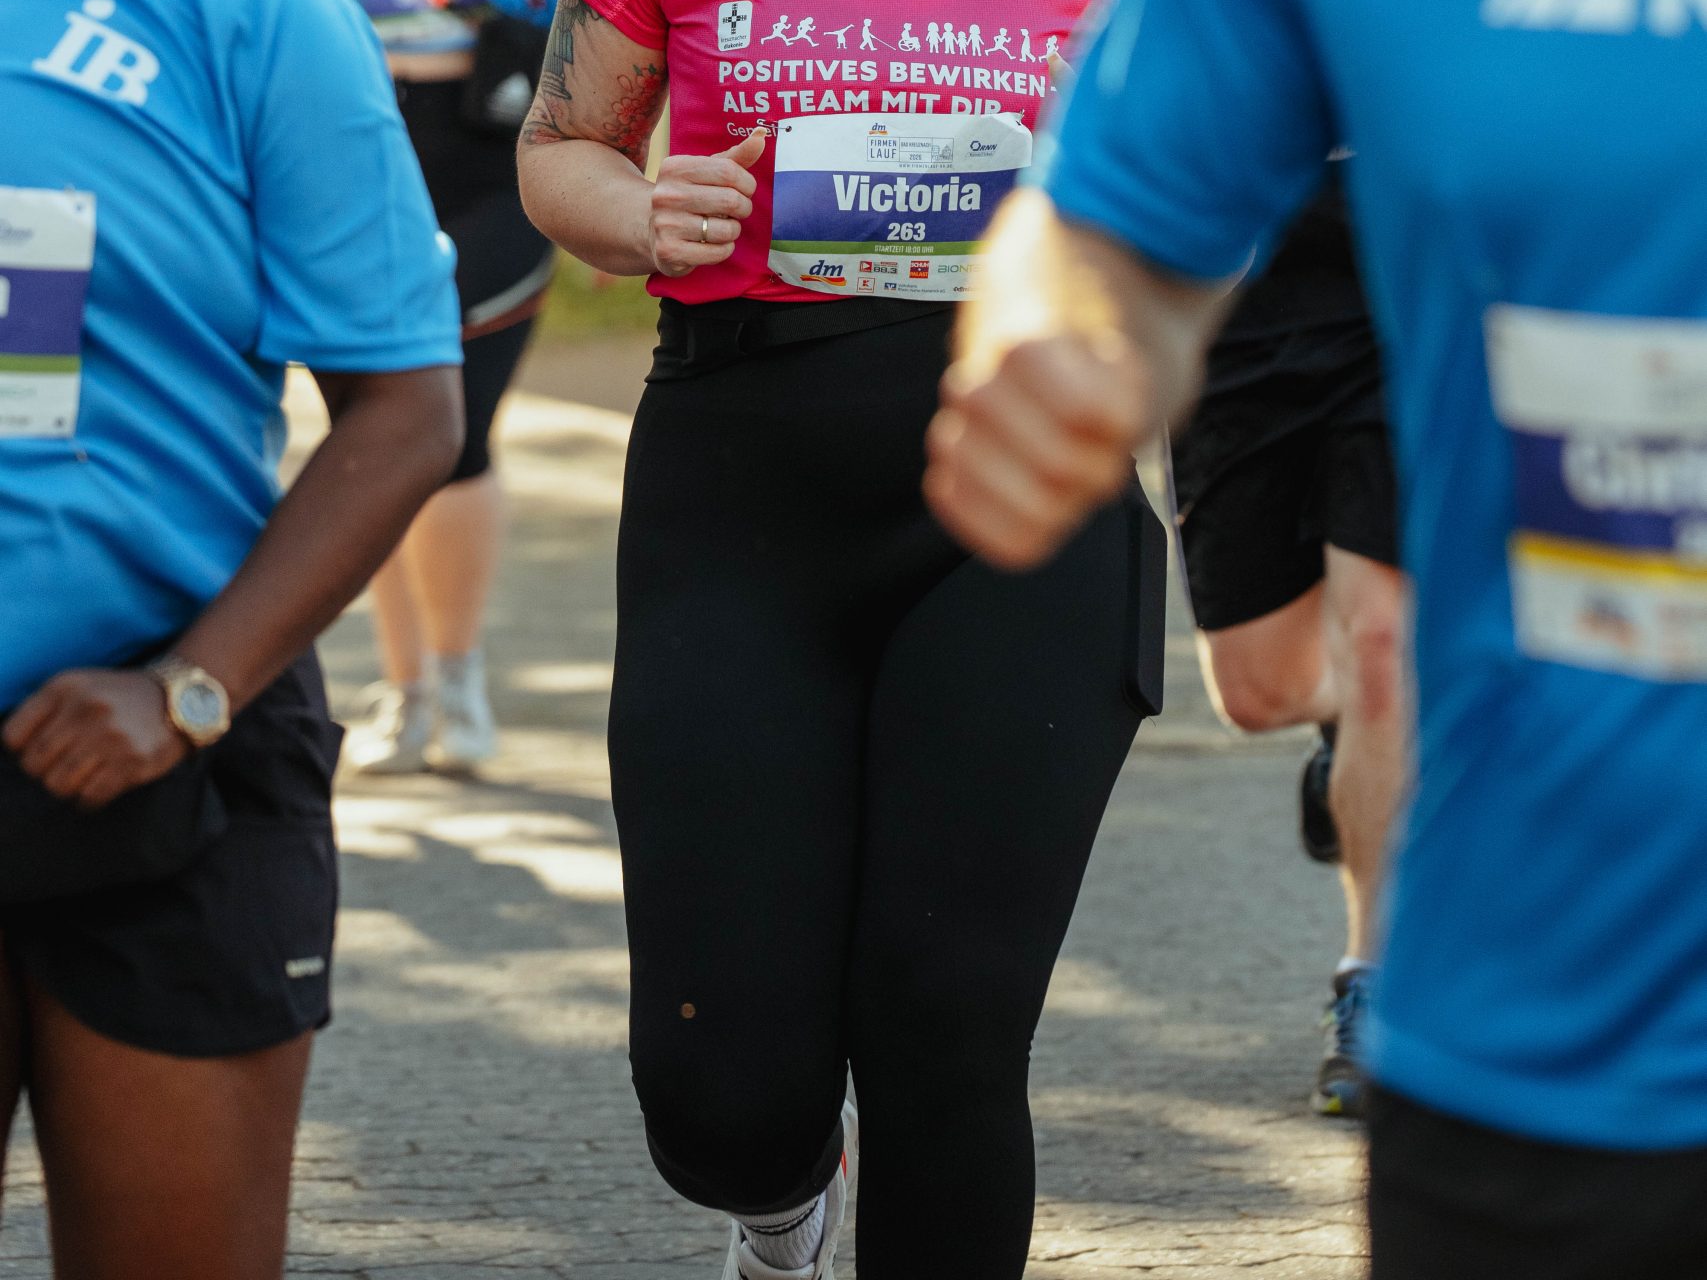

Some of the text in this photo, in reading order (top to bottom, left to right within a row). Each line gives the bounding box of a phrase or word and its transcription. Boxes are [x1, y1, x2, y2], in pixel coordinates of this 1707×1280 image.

[718, 59, 878, 83] POSITIVES
[723, 89, 1003, 115] ALS TEAM MIT DIR
[871, 123, 887, 131] dm
[870, 139, 897, 147] FIRMEN
[870, 148, 897, 159] LAUF
[833, 174, 981, 212] Victoria
[886, 222, 926, 241] 263
[874, 245, 904, 253] STARTZEIT
[808, 260, 844, 277] dm
[873, 266, 897, 274] 88.3
